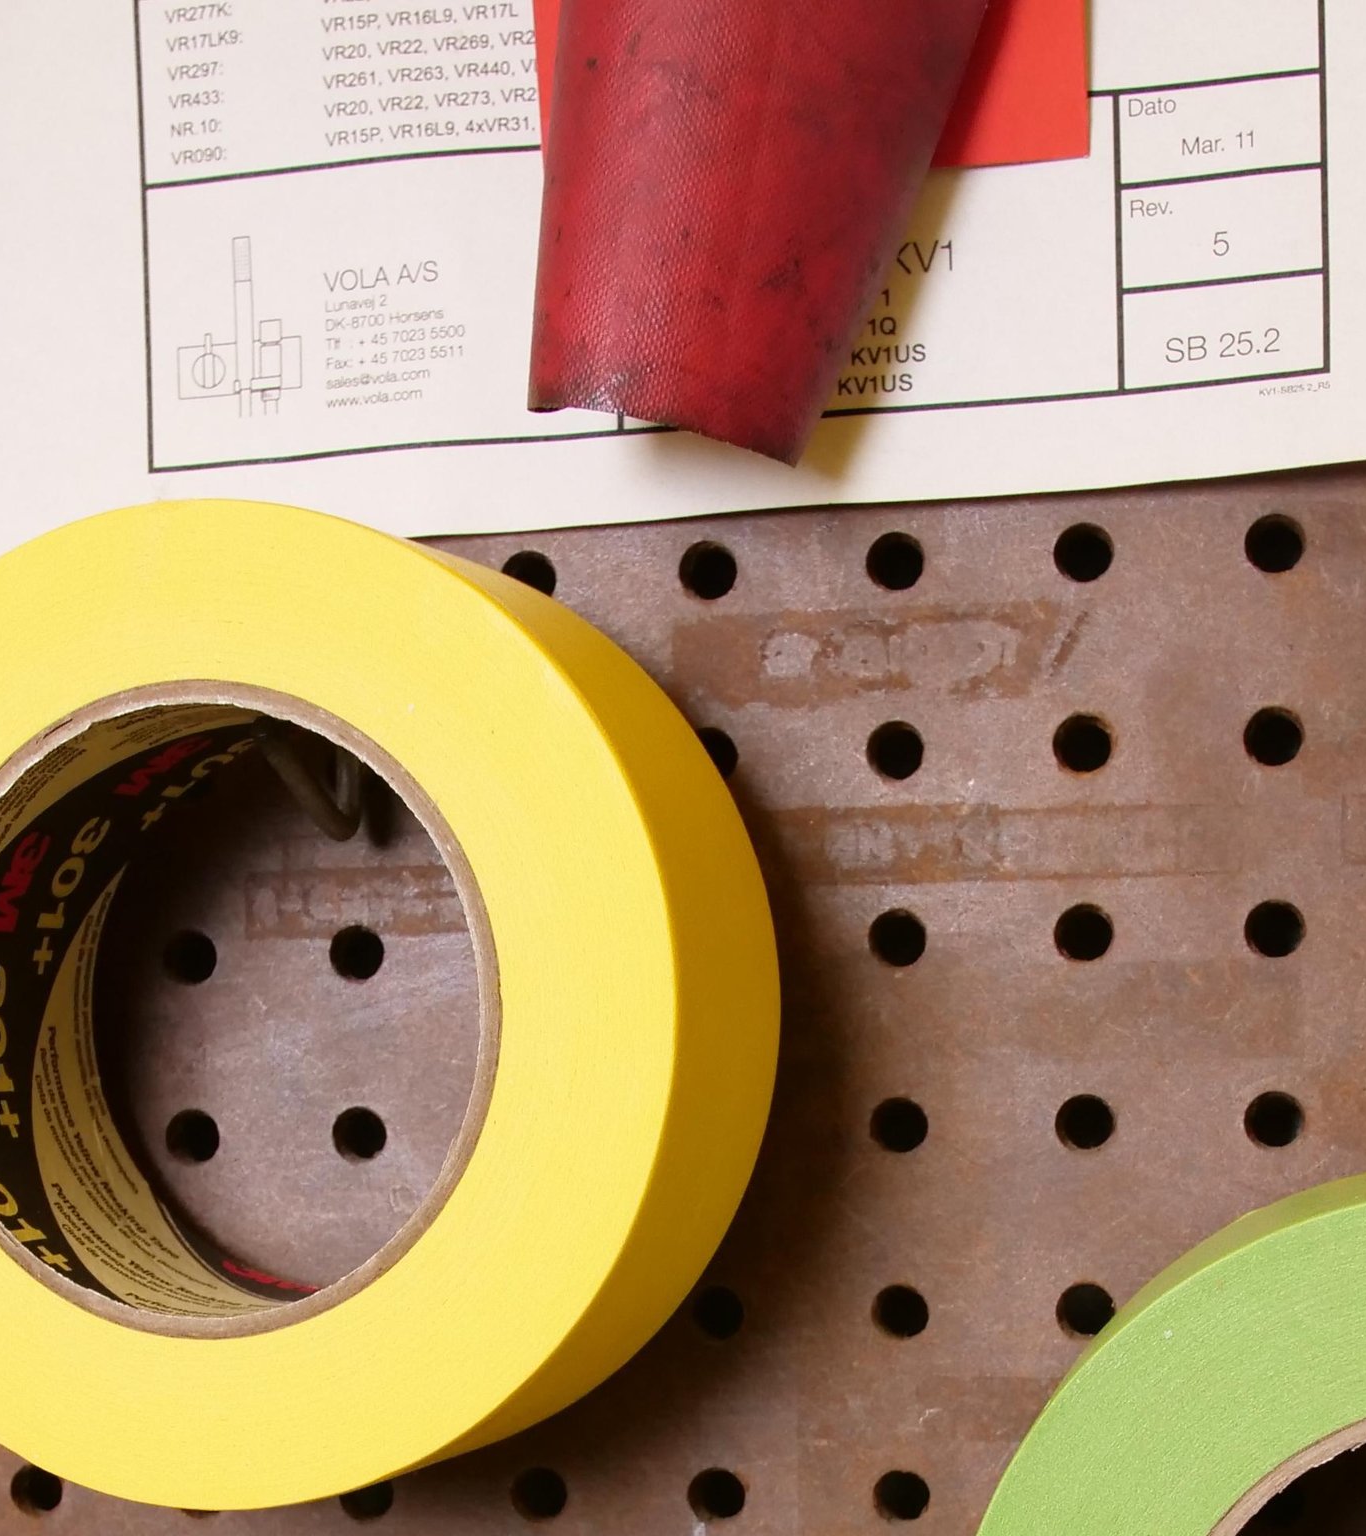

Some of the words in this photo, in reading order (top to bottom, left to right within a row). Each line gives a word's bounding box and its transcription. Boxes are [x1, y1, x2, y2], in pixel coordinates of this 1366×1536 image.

[165, 3, 233, 24] VR277K:
[321, 14, 382, 32] VR15P,
[386, 8, 457, 27] VR16L9,
[463, 3, 519, 21] VR17L
[166, 29, 244, 52] VR17LK9:
[322, 43, 372, 61] VR20,
[377, 39, 428, 56] VR22,
[433, 34, 495, 52] VR269,
[167, 61, 224, 81] VR297:
[323, 72, 383, 90] VR261,
[388, 66, 449, 83] VR263,
[454, 61, 515, 78] VR440,
[168, 90, 226, 110] VR433:
[324, 100, 373, 118] VR20,
[378, 95, 429, 112] VR22,
[435, 91, 495, 108] VR273,
[1127, 97, 1177, 118] Dato
[325, 127, 384, 147] VR15P,
[389, 121, 460, 140] VR16L9,
[1181, 136, 1225, 157] Mar.
[1235, 130, 1255, 149] 11
[1129, 199, 1174, 218] Rev.
[1212, 231, 1230, 256] 5
[323, 266, 390, 293] VOLA
[396, 260, 439, 285] A/S
[379, 294, 388, 307] 2
[325, 313, 384, 332] DK-8700
[389, 308, 444, 324] Horsens
[370, 332, 388, 346] 45
[392, 328, 426, 344] 7023
[430, 324, 466, 340] 5500
[1165, 334, 1208, 363] SB
[1219, 328, 1281, 358] 25.2
[370, 351, 388, 366] 45
[392, 347, 426, 363] 7023
[430, 344, 464, 360] 5511
[850, 343, 926, 366] KV1US
[837, 373, 913, 396] KV1US
[33, 816, 111, 976] 301+
